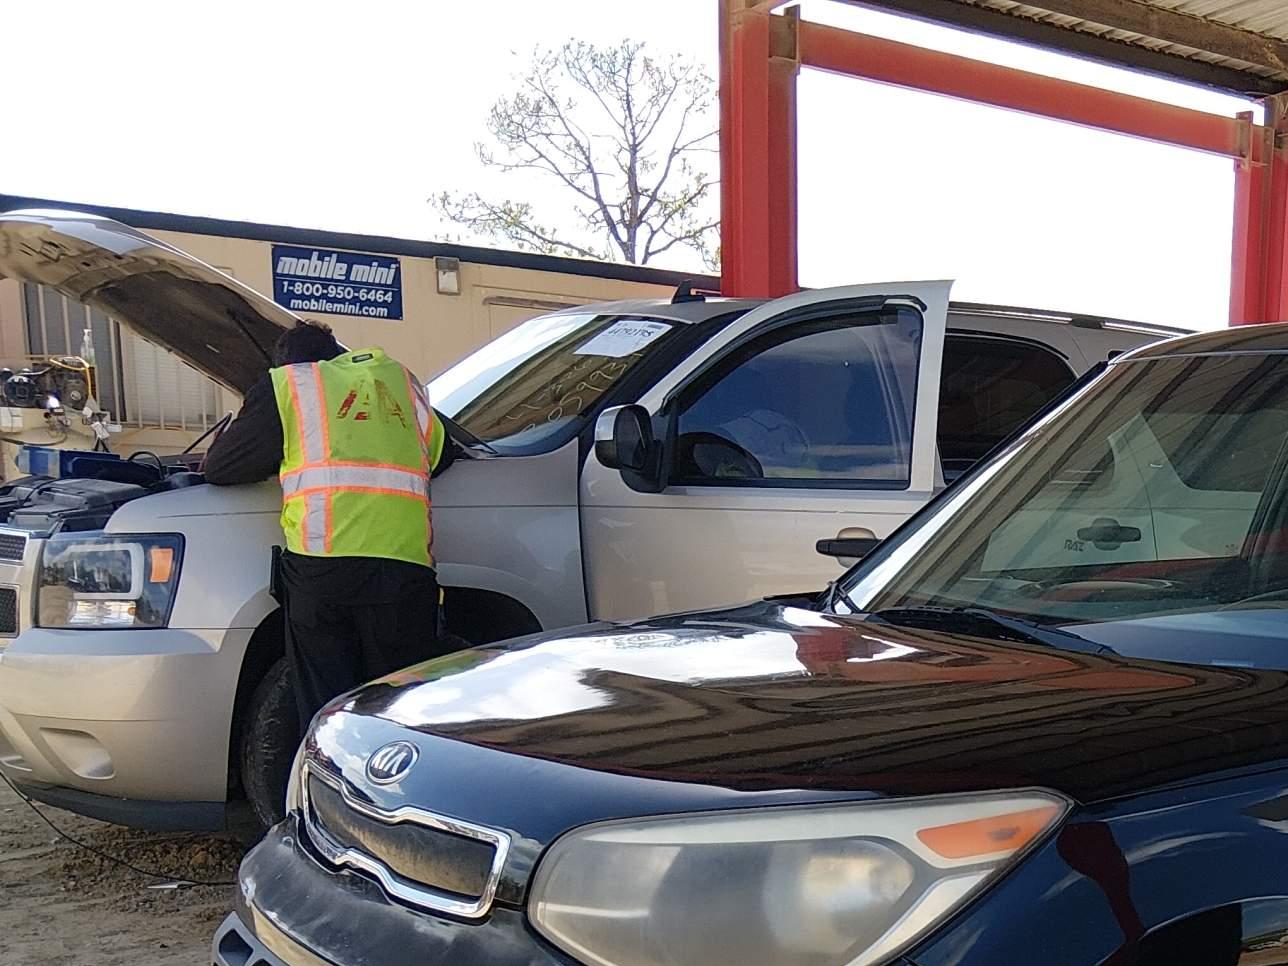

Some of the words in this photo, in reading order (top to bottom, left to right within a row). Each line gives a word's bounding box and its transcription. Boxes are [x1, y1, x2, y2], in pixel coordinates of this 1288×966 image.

[276, 251, 347, 280] mobile
[350, 262, 397, 285] mini
[282, 281, 393, 304] 1-800-950-6464
[290, 298, 388, 317] mobilemini.com
[370, 746, 408, 776] KIA
